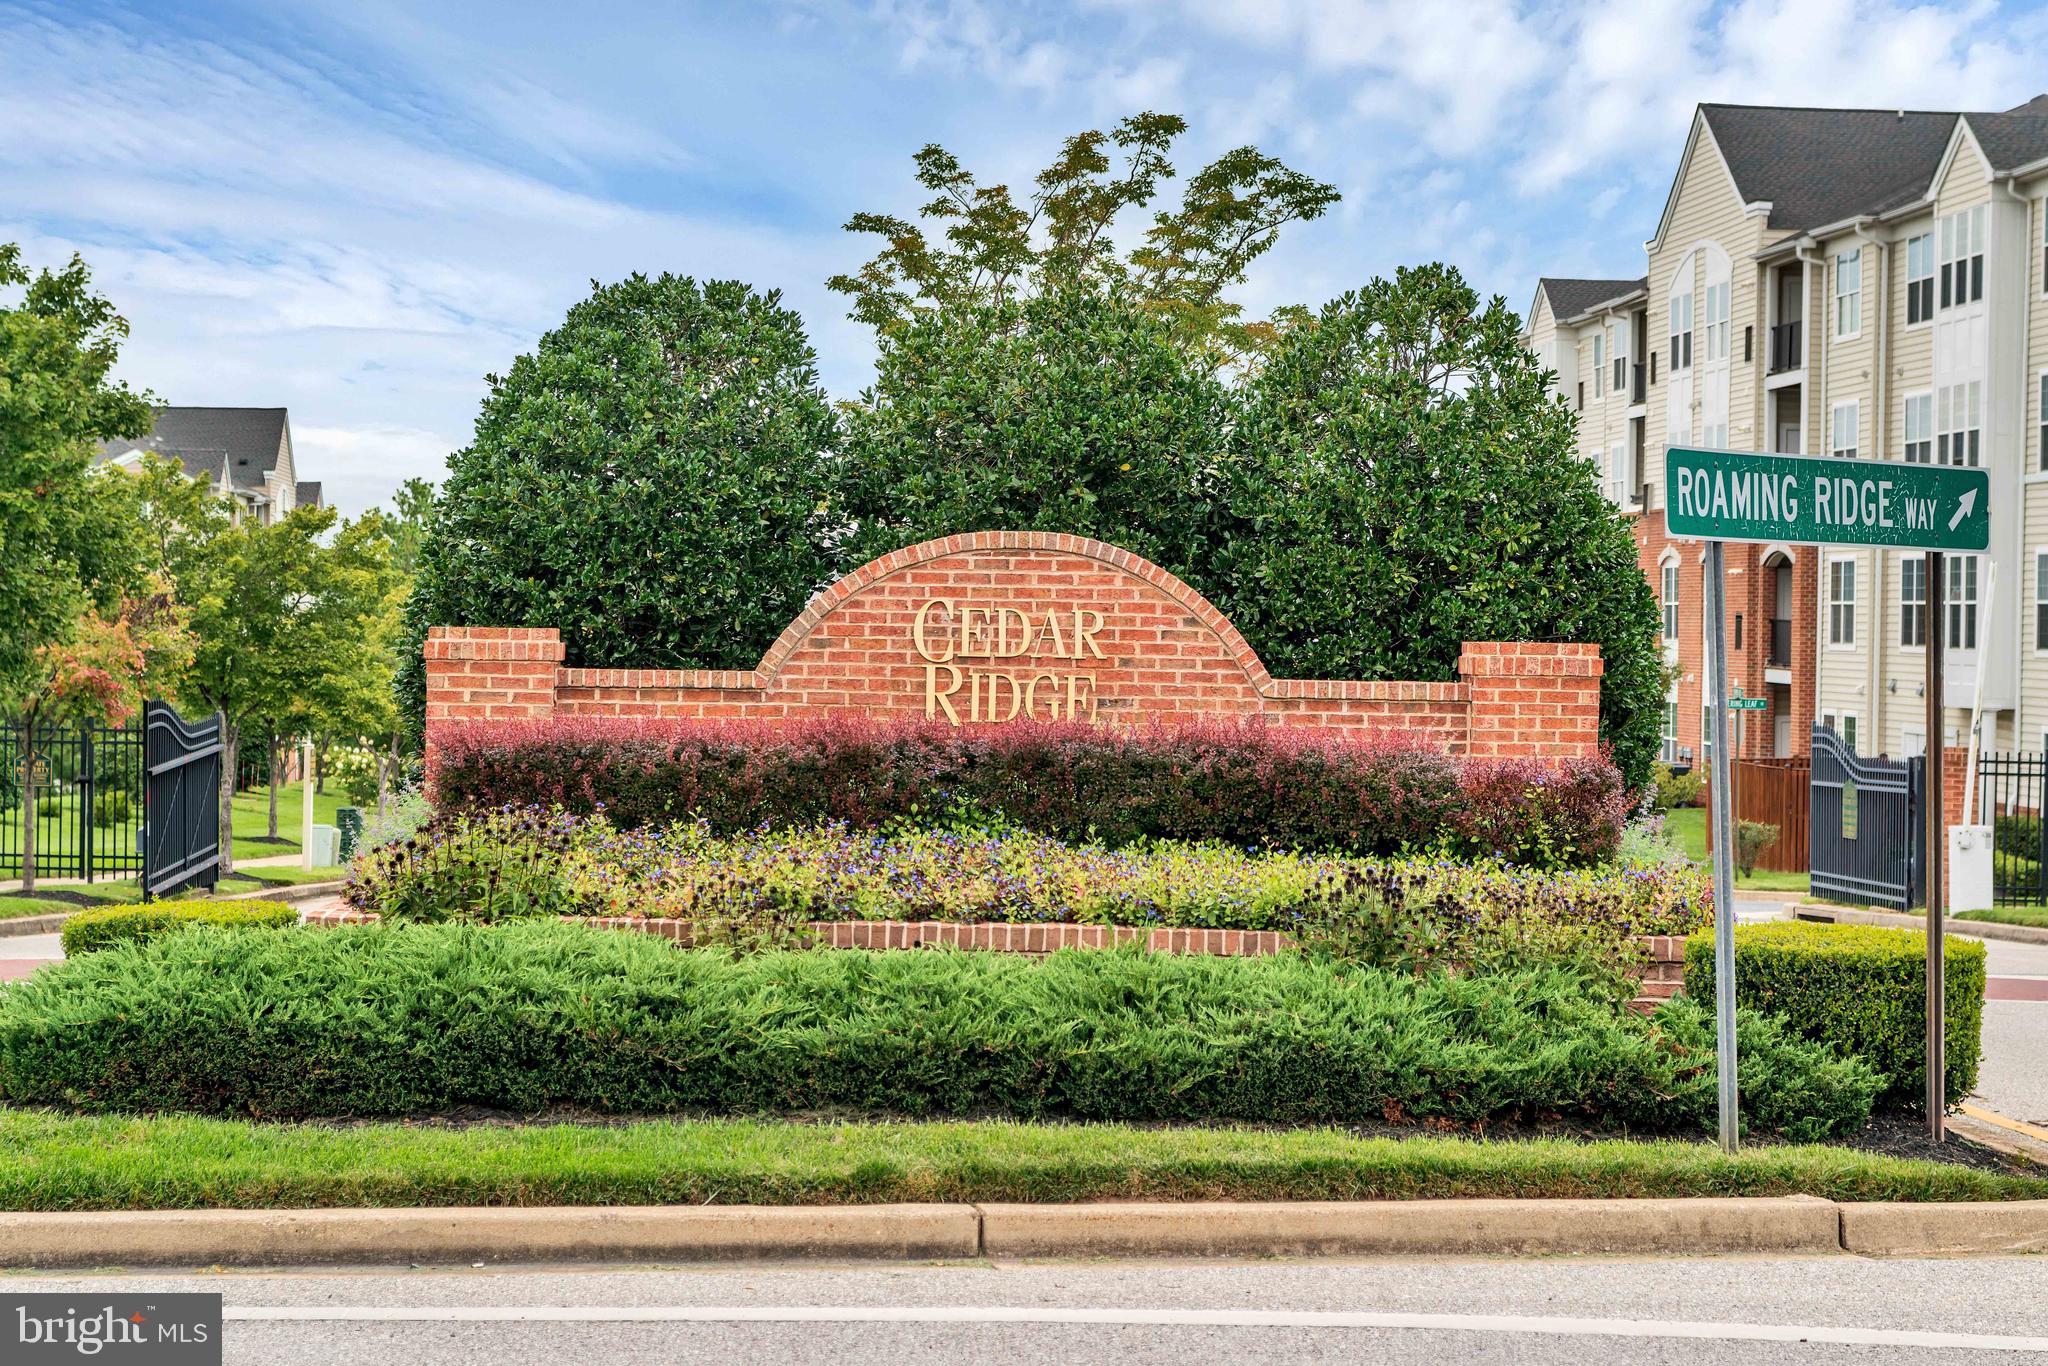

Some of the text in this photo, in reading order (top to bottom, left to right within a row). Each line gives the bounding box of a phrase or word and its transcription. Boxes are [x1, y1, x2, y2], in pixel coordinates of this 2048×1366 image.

[1677, 466, 1938, 531] ROAMING RIDGE WAY
[913, 599, 1107, 663] CEDAR
[922, 665, 1097, 727] RIDGE
